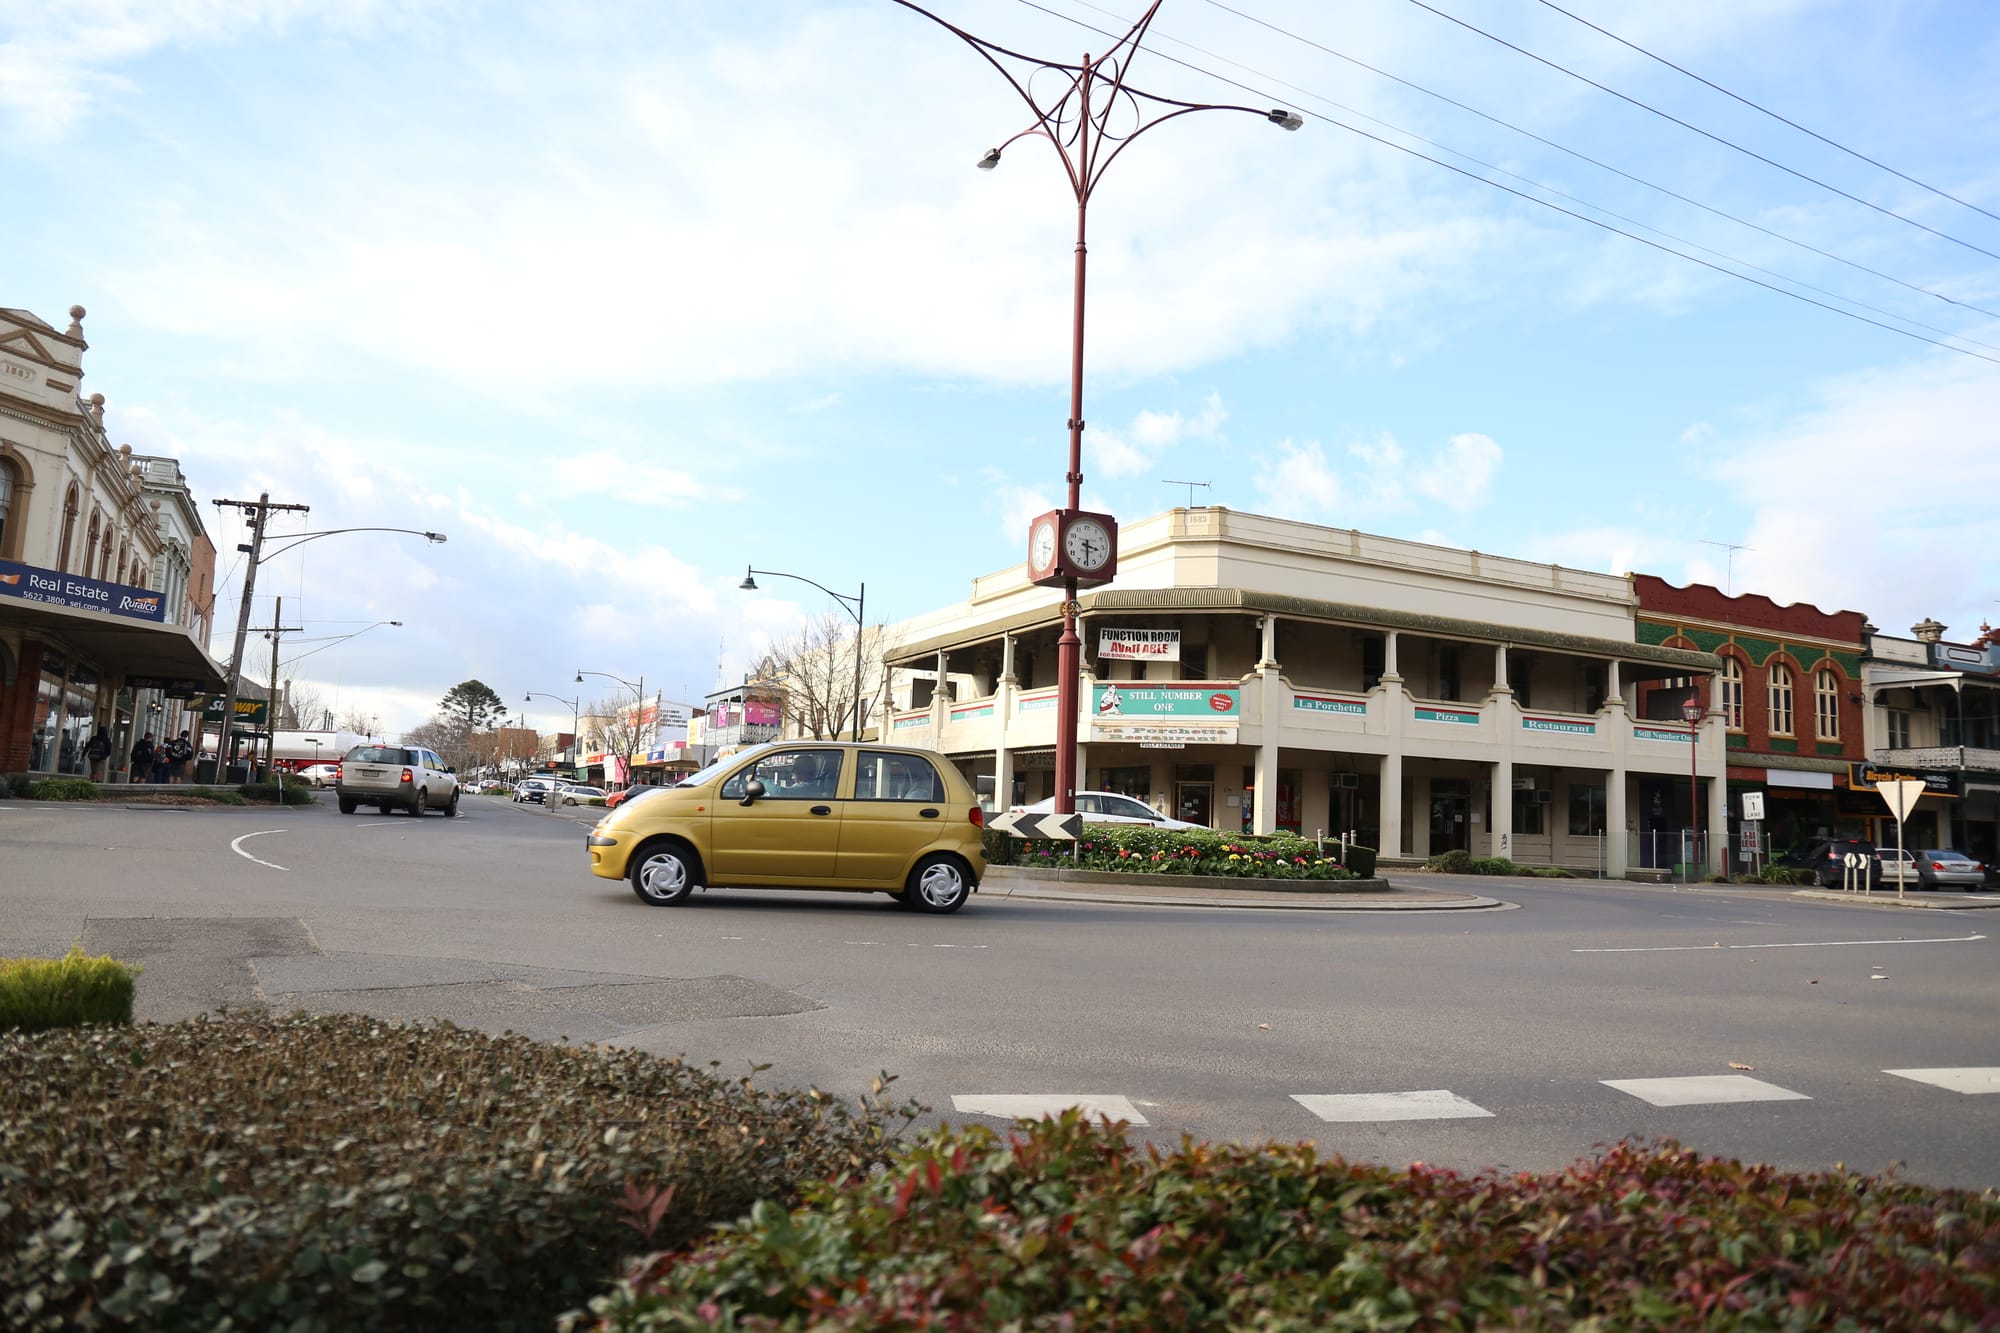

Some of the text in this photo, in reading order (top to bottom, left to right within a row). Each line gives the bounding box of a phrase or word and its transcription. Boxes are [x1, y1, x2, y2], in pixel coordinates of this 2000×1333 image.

[29, 574, 109, 602] Real Estate
[23, 590, 66, 606] 5622 3800
[119, 595, 157, 612] Ruralco
[1101, 629, 1179, 642] FUNCTION ROOM
[1129, 691, 1156, 700] STILL
[1160, 691, 1202, 701] NUMBER
[208, 700, 264, 714] SUWAY
[1153, 702, 1175, 712] ONE
[1299, 700, 1362, 713] La Porchetta
[1435, 711, 1459, 722] Pizza
[1129, 727, 1228, 735] Porchetta
[1528, 720, 1590, 733] Restaurant
[1108, 734, 1218, 742] Restaurant
[1637, 729, 1651, 738] Still
[1652, 731, 1680, 741] Number
[1866, 770, 1892, 782] Bicycle
[1751, 802, 1756, 810] 1
